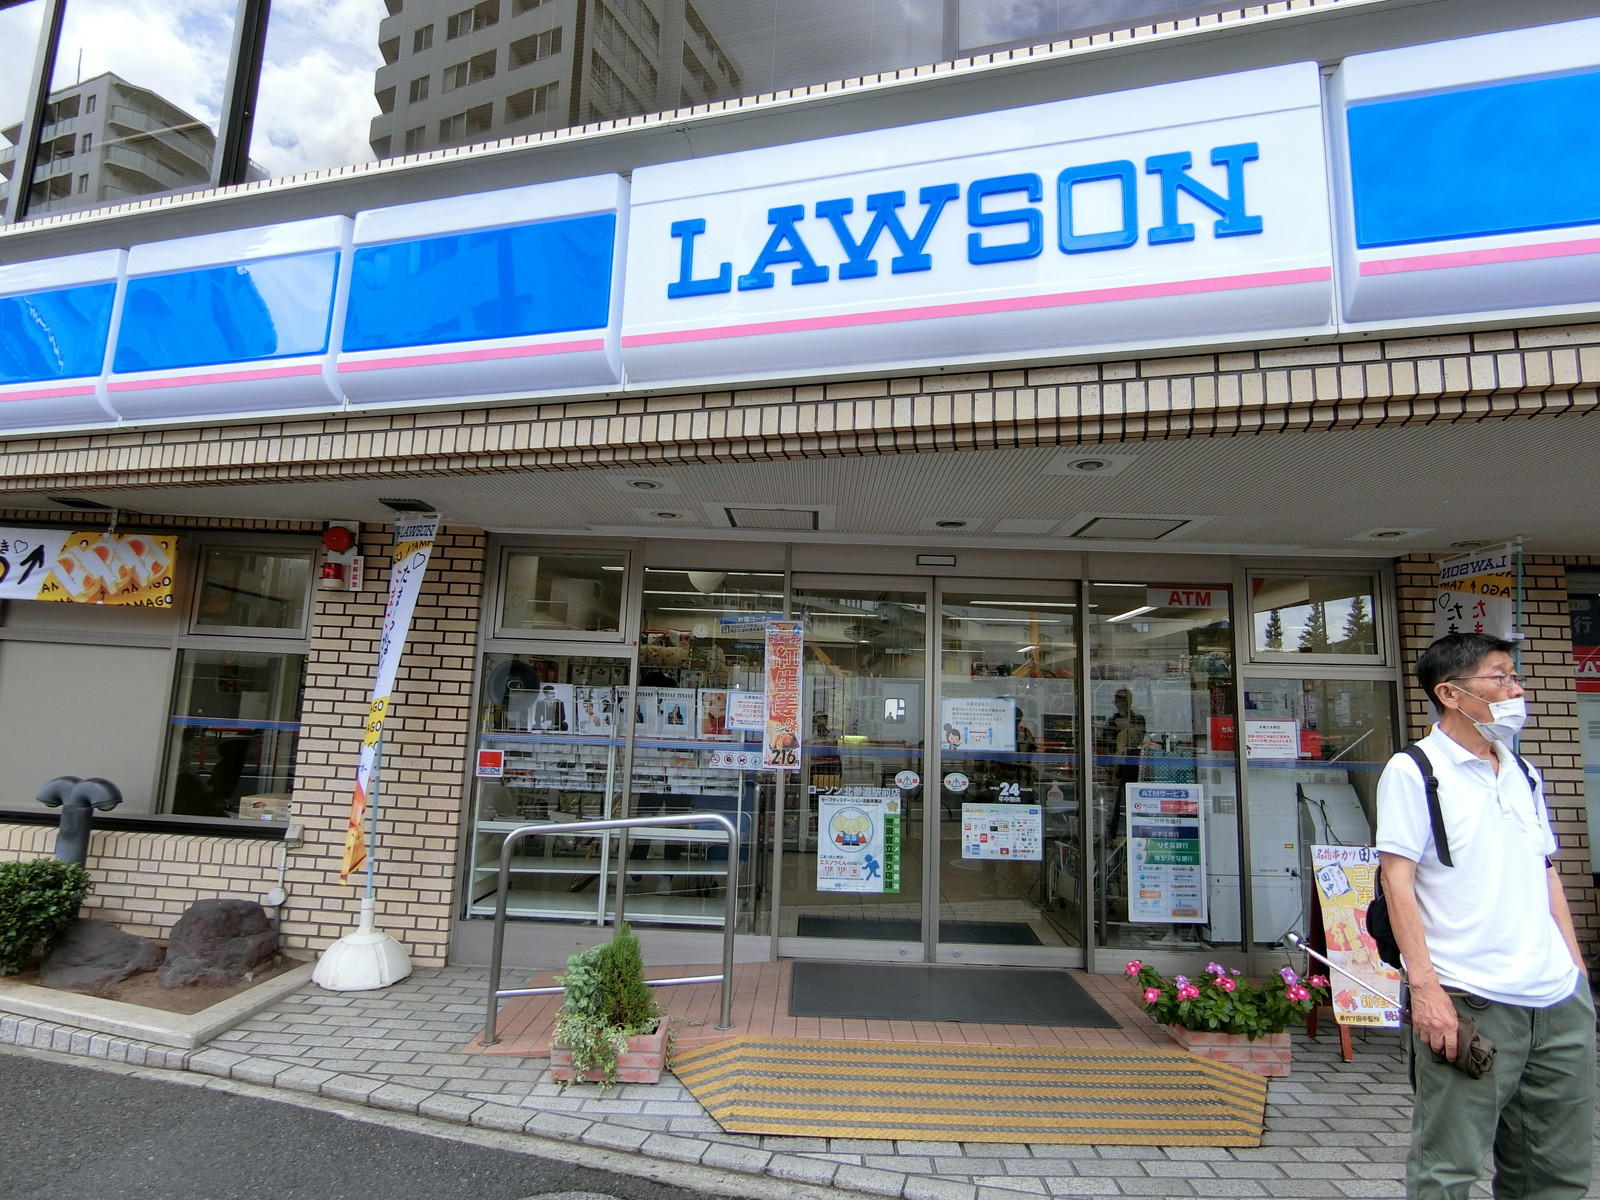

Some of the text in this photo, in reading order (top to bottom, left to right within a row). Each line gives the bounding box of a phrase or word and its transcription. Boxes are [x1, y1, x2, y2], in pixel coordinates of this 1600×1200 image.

[667, 141, 1263, 300] LAWSON
[1167, 590, 1212, 607] ATM
[999, 781, 1021, 797] 24
[1141, 789, 1187, 798] ATMサービス
[1157, 841, 1189, 849] りそな銀行
